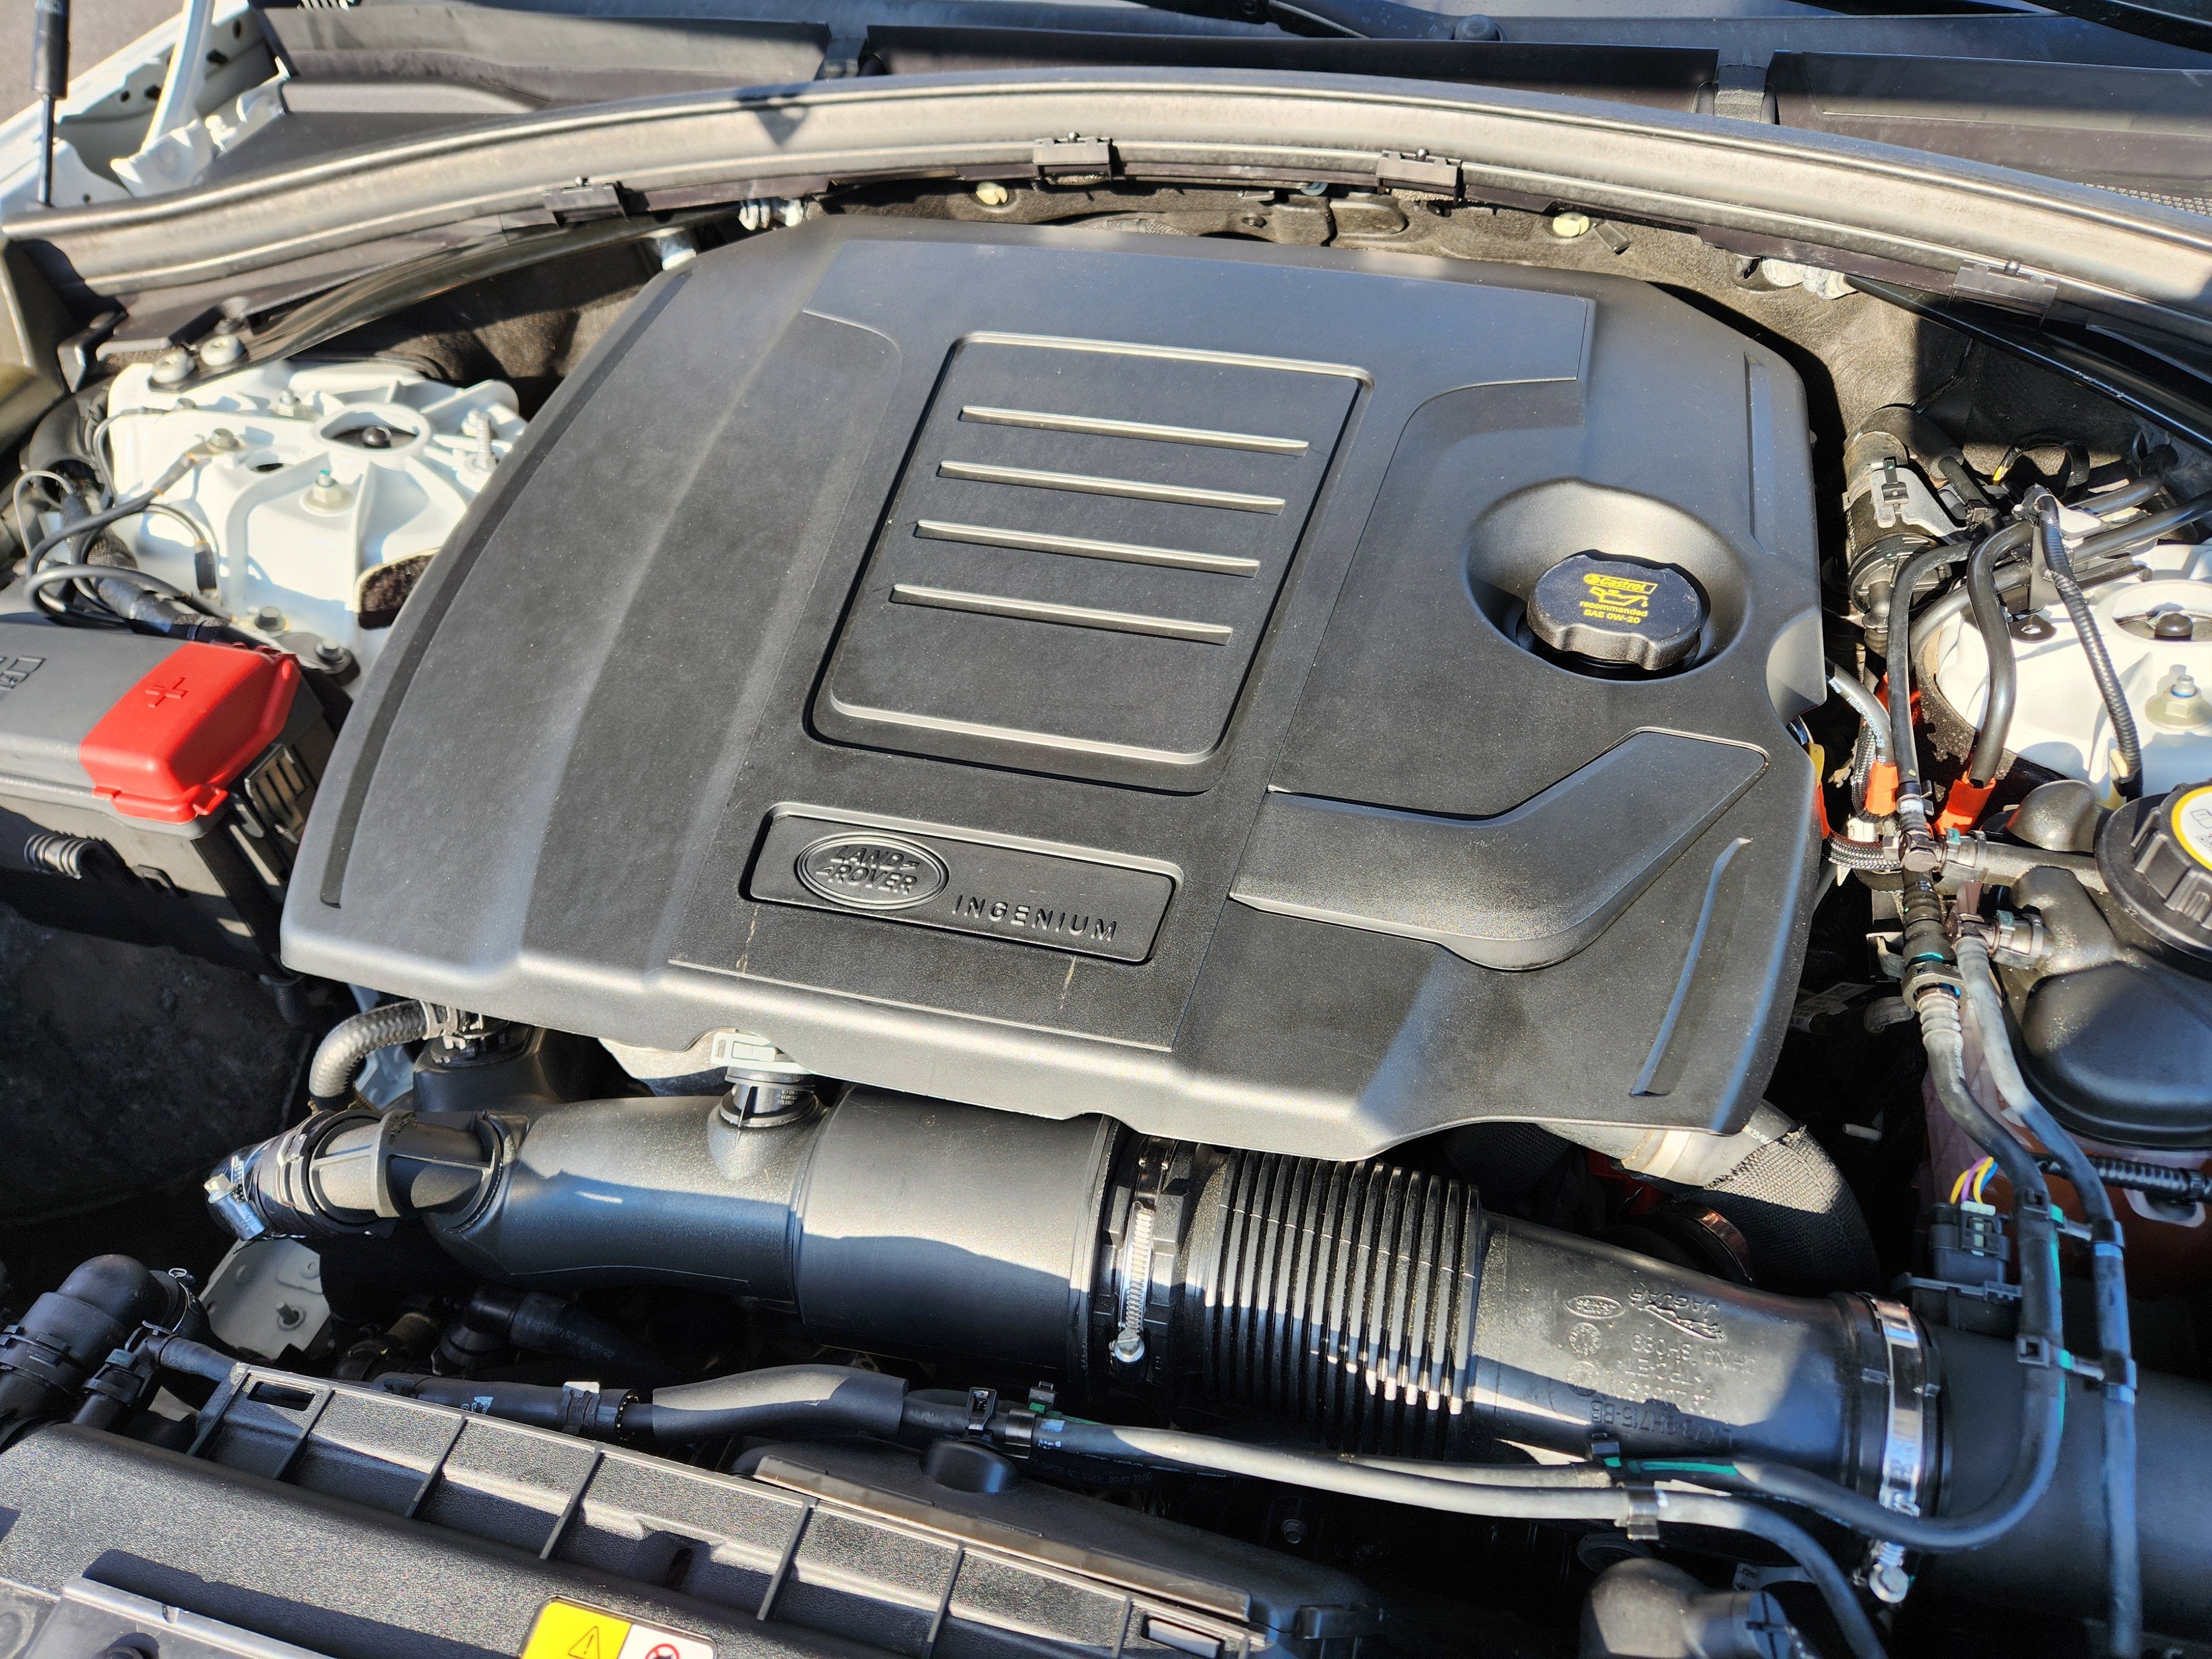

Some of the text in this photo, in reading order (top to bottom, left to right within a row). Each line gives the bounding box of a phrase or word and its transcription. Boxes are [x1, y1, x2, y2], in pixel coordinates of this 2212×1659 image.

[1599, 576, 1646, 592] Castrol
[1579, 601, 1648, 617] recommended
[1584, 609, 1641, 624] SAE 0W-20
[830, 845, 905, 871] LAND
[827, 865, 919, 895] ROVER
[952, 894, 1118, 942] INGENIUM
[1630, 1289, 1719, 1313] JAGUAR
